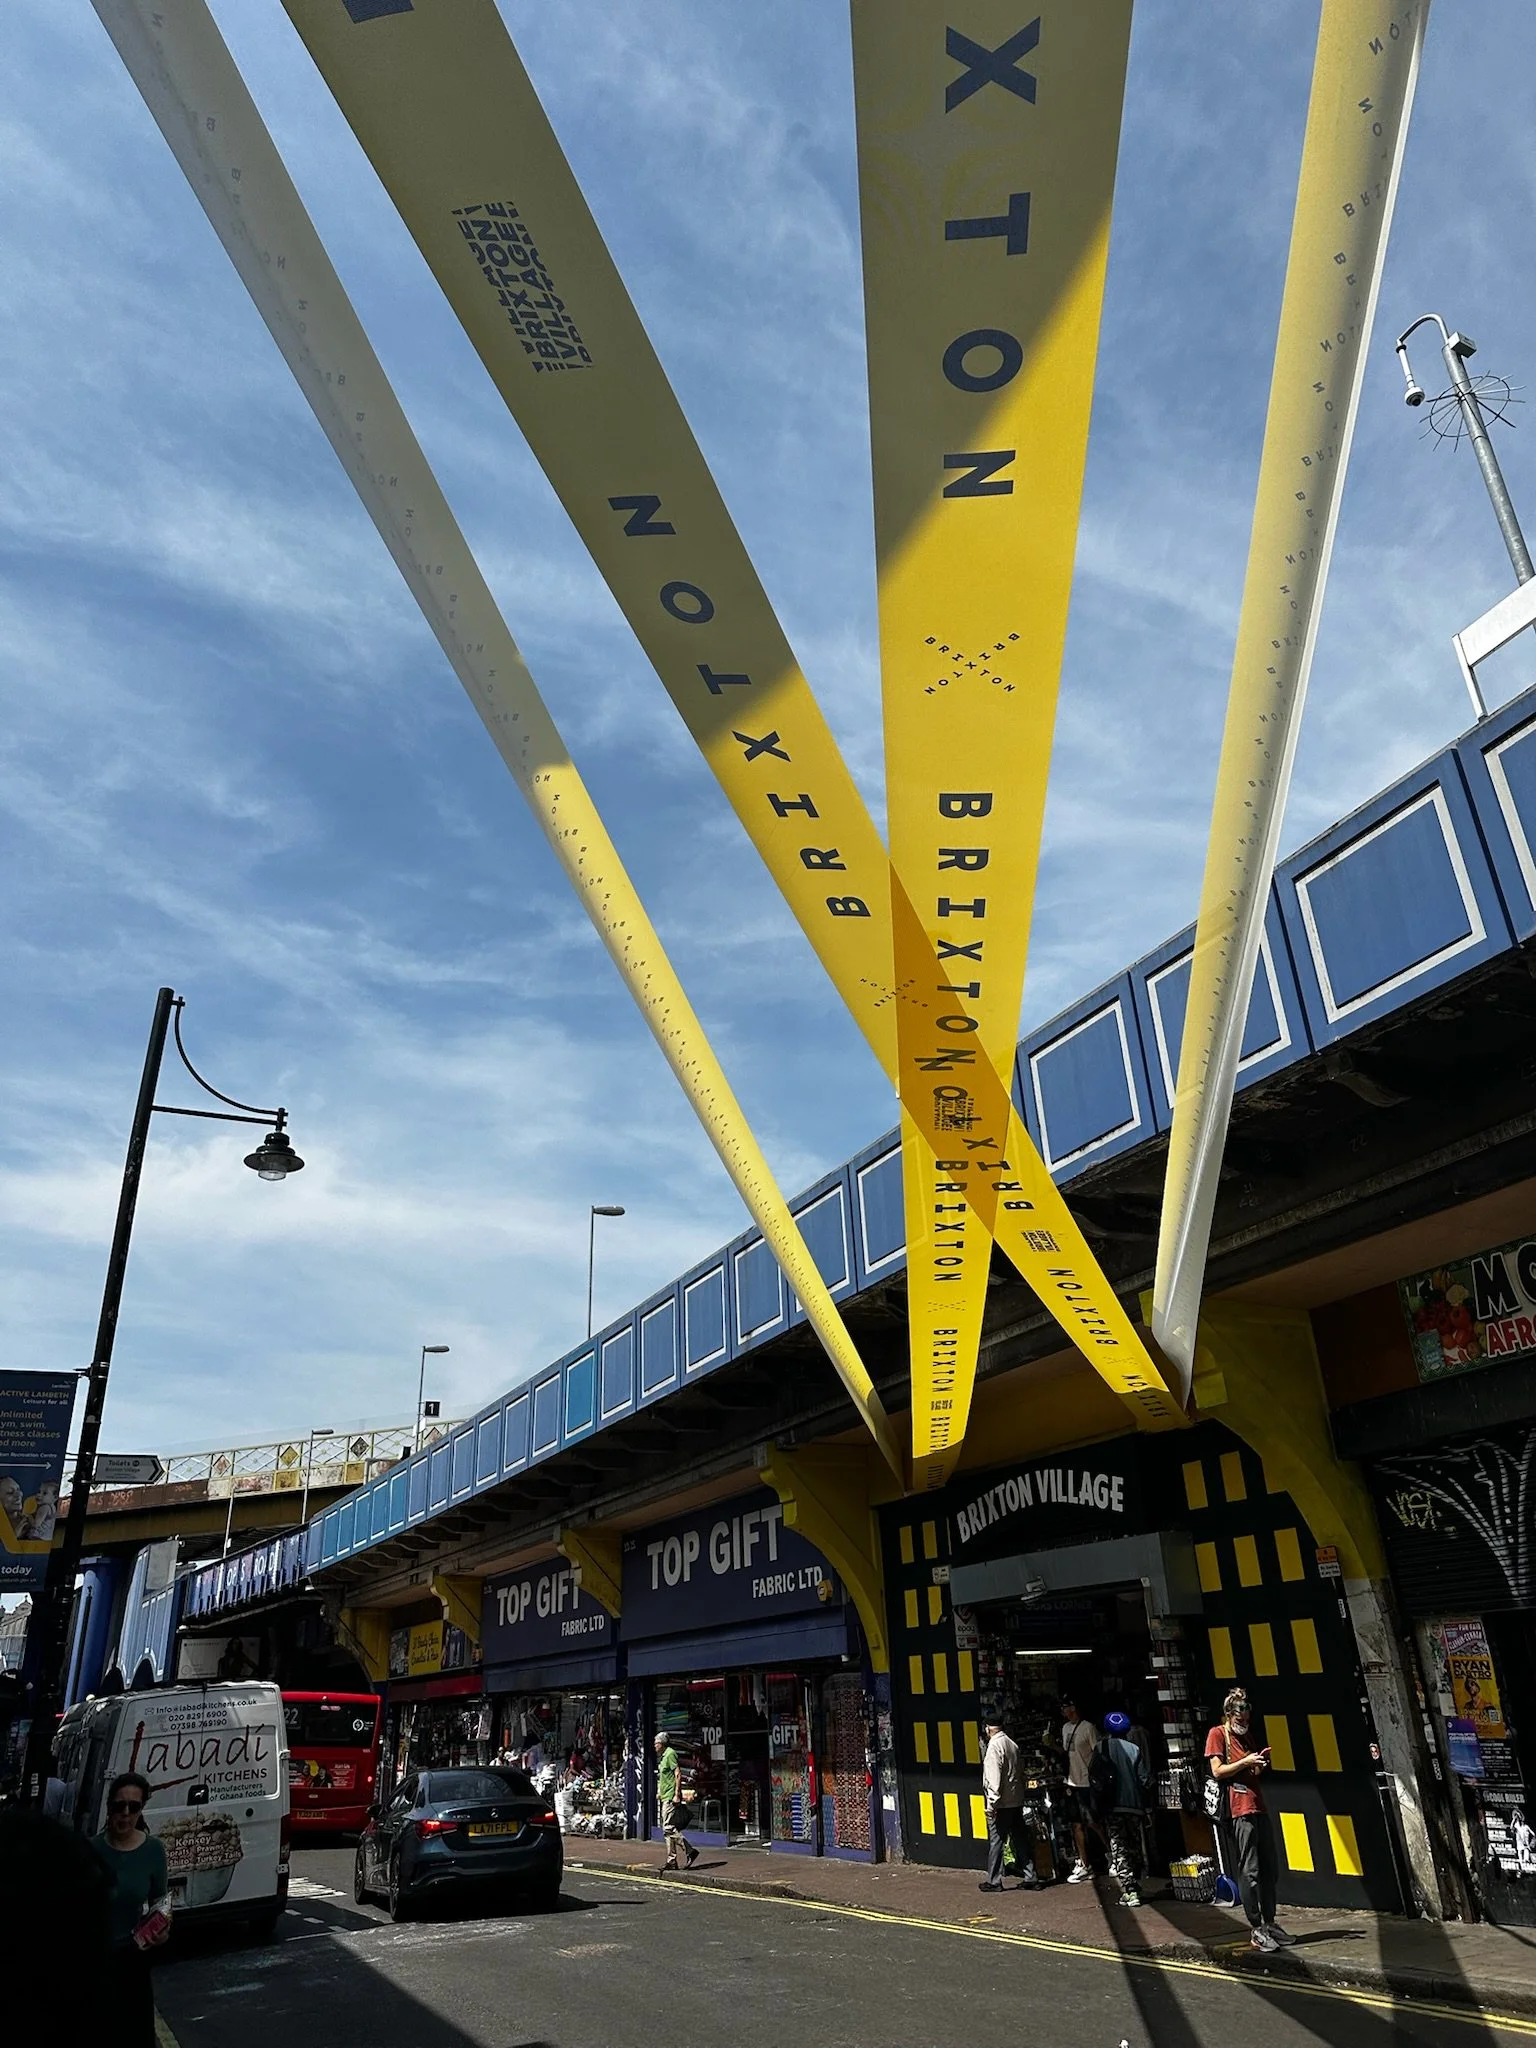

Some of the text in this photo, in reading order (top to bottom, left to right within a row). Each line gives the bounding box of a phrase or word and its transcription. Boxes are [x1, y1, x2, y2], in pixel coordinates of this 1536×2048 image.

[924, 635, 1016, 693] BRIXTON
[607, 495, 872, 918] BRIXTON
[936, 792, 993, 1064] BRIXTON
[933, 1160, 969, 1281] BRIXTON
[1046, 1268, 1120, 1346] BRIXTON
[1486, 1314, 1536, 1359] AFR
[932, 1328, 958, 1393] BRIXTON
[31, 1391, 69, 1399] LAMBETH
[429, 1403, 434, 1414] 1
[0, 1421, 17, 1429] ym,
[27, 1430, 61, 1438] classes
[956, 1473, 1034, 1543] BRIXTON
[1035, 1468, 1124, 1512] VILLAGE
[647, 1503, 783, 1590] TOP GIFT
[1, 1565, 32, 1575] today
[752, 1566, 823, 1599] FABRIC LTD
[497, 1569, 582, 1627] TOP GIFT
[561, 1614, 605, 1637] FABRIC LTD
[1453, 1661, 1491, 1671] RYAN
[1454, 1670, 1492, 1678] CASTRO
[169, 1713, 184, 1722] 020
[206, 1710, 228, 1720] 6900
[171, 1721, 196, 1731] 07398
[702, 1727, 722, 1745] TOP
[772, 1725, 799, 1745] GIFT
[204, 1768, 268, 1785] KITCHENS
[209, 1788, 267, 1802] of Ghana foods
[210, 1783, 263, 1794] Manufacturers
[473, 1824, 494, 1834] LA71
[176, 1834, 212, 1848] Kenkey
[196, 1844, 224, 1853] Prawns
[196, 1854, 222, 1863] Turkey
[224, 1850, 242, 1860] Tails
